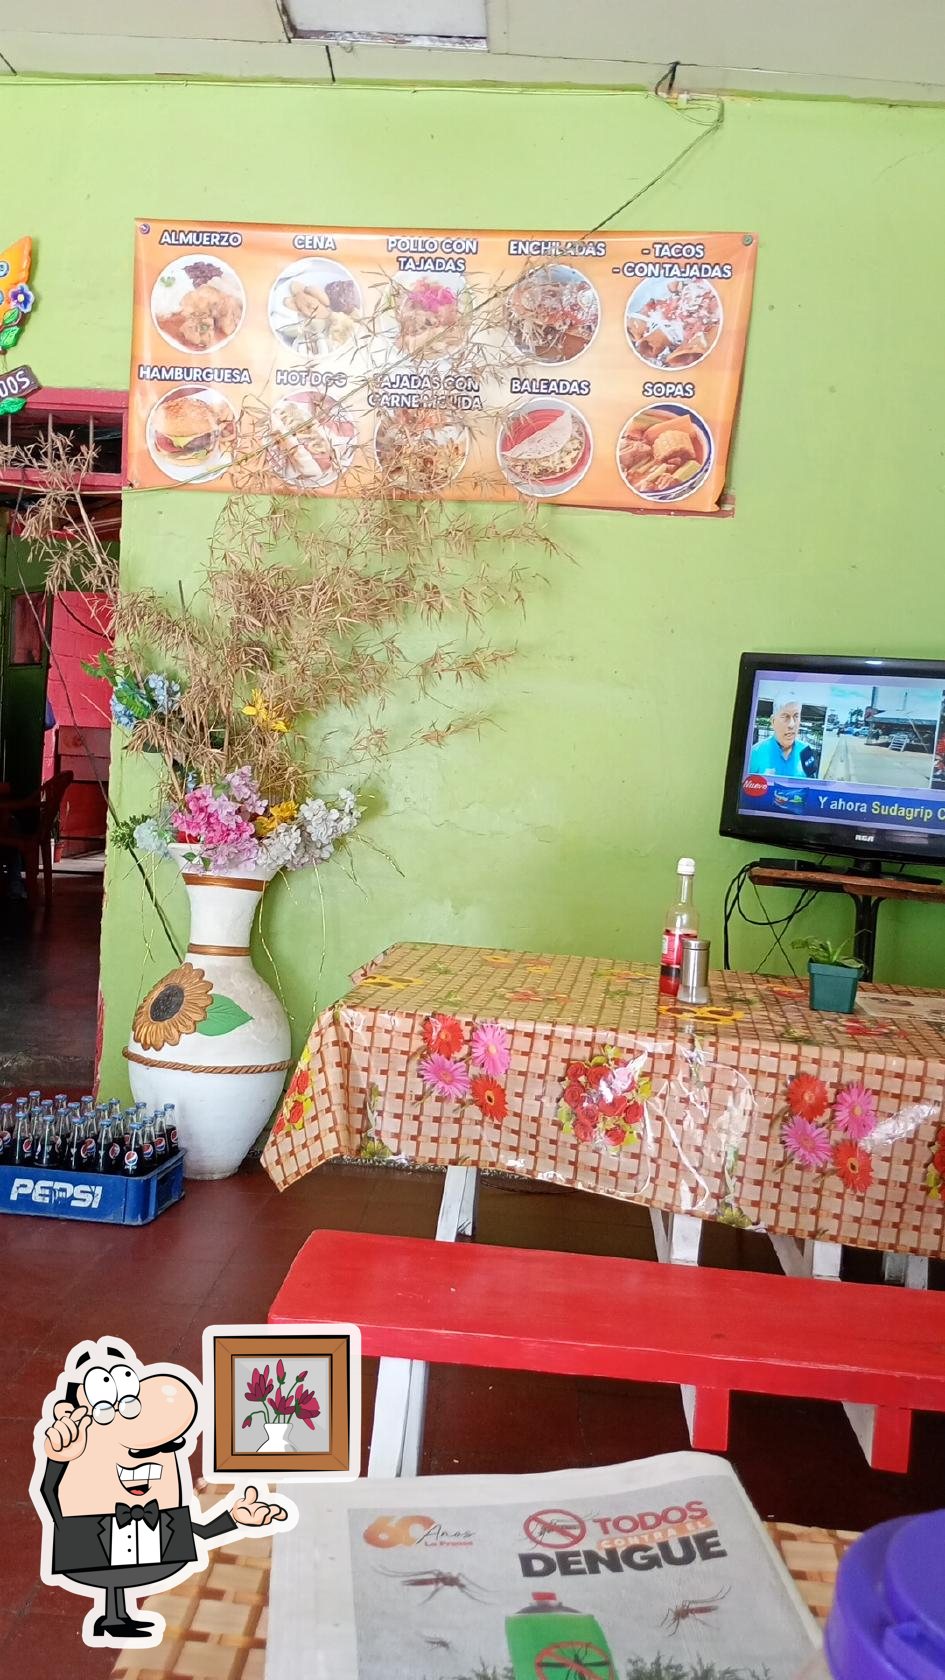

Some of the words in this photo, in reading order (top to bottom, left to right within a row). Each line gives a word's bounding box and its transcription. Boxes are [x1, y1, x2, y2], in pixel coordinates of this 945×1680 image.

[159, 230, 243, 248] ALMUERZO
[293, 235, 336, 251] CENA
[387, 236, 438, 253] POLLO
[441, 237, 478, 254] CON
[508, 240, 606, 257] ENCHILADAS
[652, 242, 705, 259] TACOS
[397, 256, 466, 272] TAJADAS
[623, 262, 660, 278] CON
[661, 263, 733, 279] TAJADAS
[138, 364, 252, 384] HAMBURGUESA
[276, 369, 309, 386] HOT
[310, 371, 348, 388] DOG
[443, 375, 481, 392] CON
[510, 377, 591, 395] BALEADAS
[642, 381, 696, 398] SOPAS
[367, 392, 420, 408] CARNE
[818, 796, 828, 809] Y
[830, 798, 867, 813] ahora
[871, 801, 933, 821] Sudagrip
[855, 833, 875, 842] RCA
[10, 1178, 103, 1209] PEPSI
[592, 1500, 708, 1535] TODOS
[363, 1515, 436, 1548] 60
[600, 1528, 677, 1548] CONTRA
[518, 1529, 728, 1577] DENGUE
